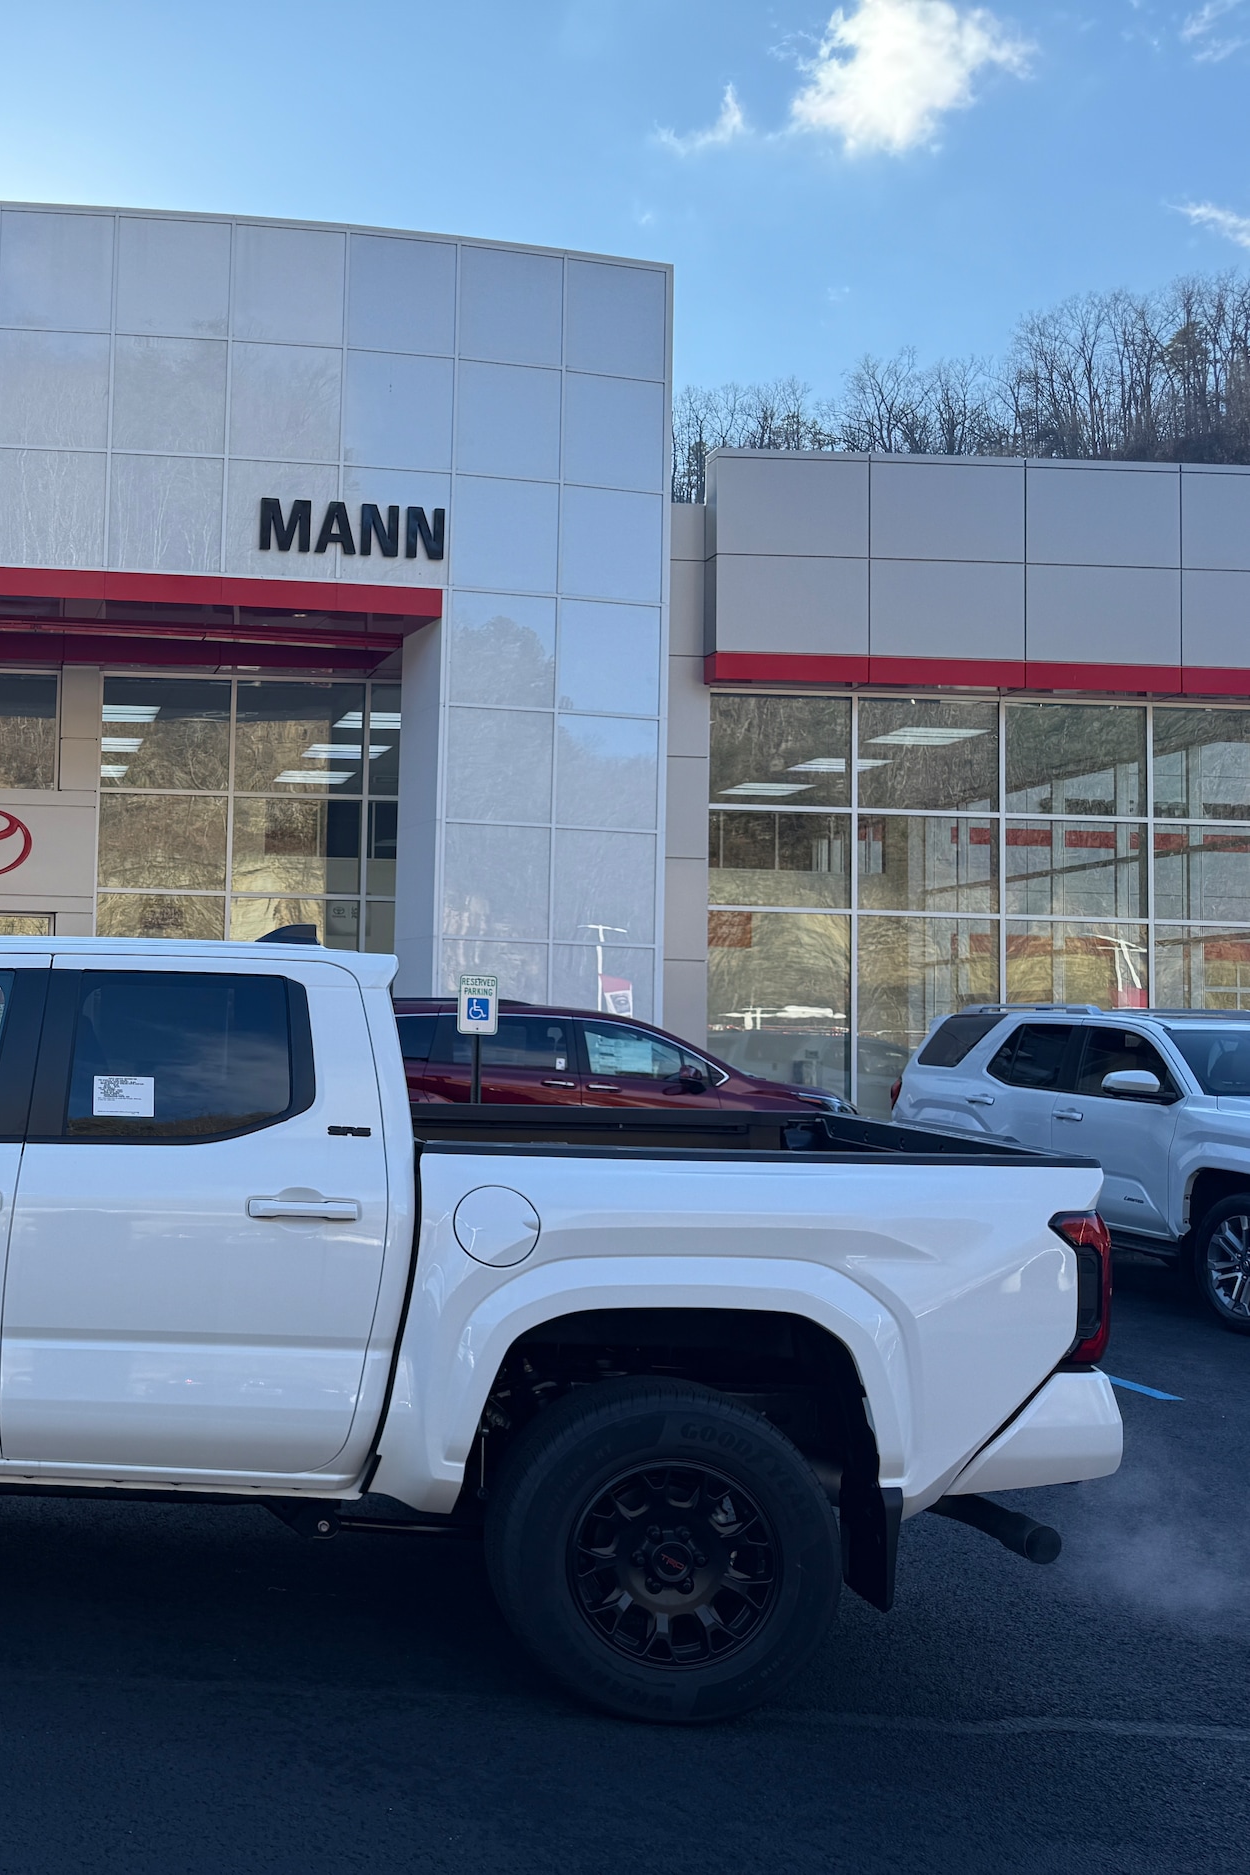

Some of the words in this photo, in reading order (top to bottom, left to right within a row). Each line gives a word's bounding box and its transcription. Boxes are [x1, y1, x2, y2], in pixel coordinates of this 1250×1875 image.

[259, 497, 445, 560] MANN
[461, 977, 496, 987] RESERVED
[464, 987, 493, 996] PARKING
[661, 1553, 685, 1570] TRD
